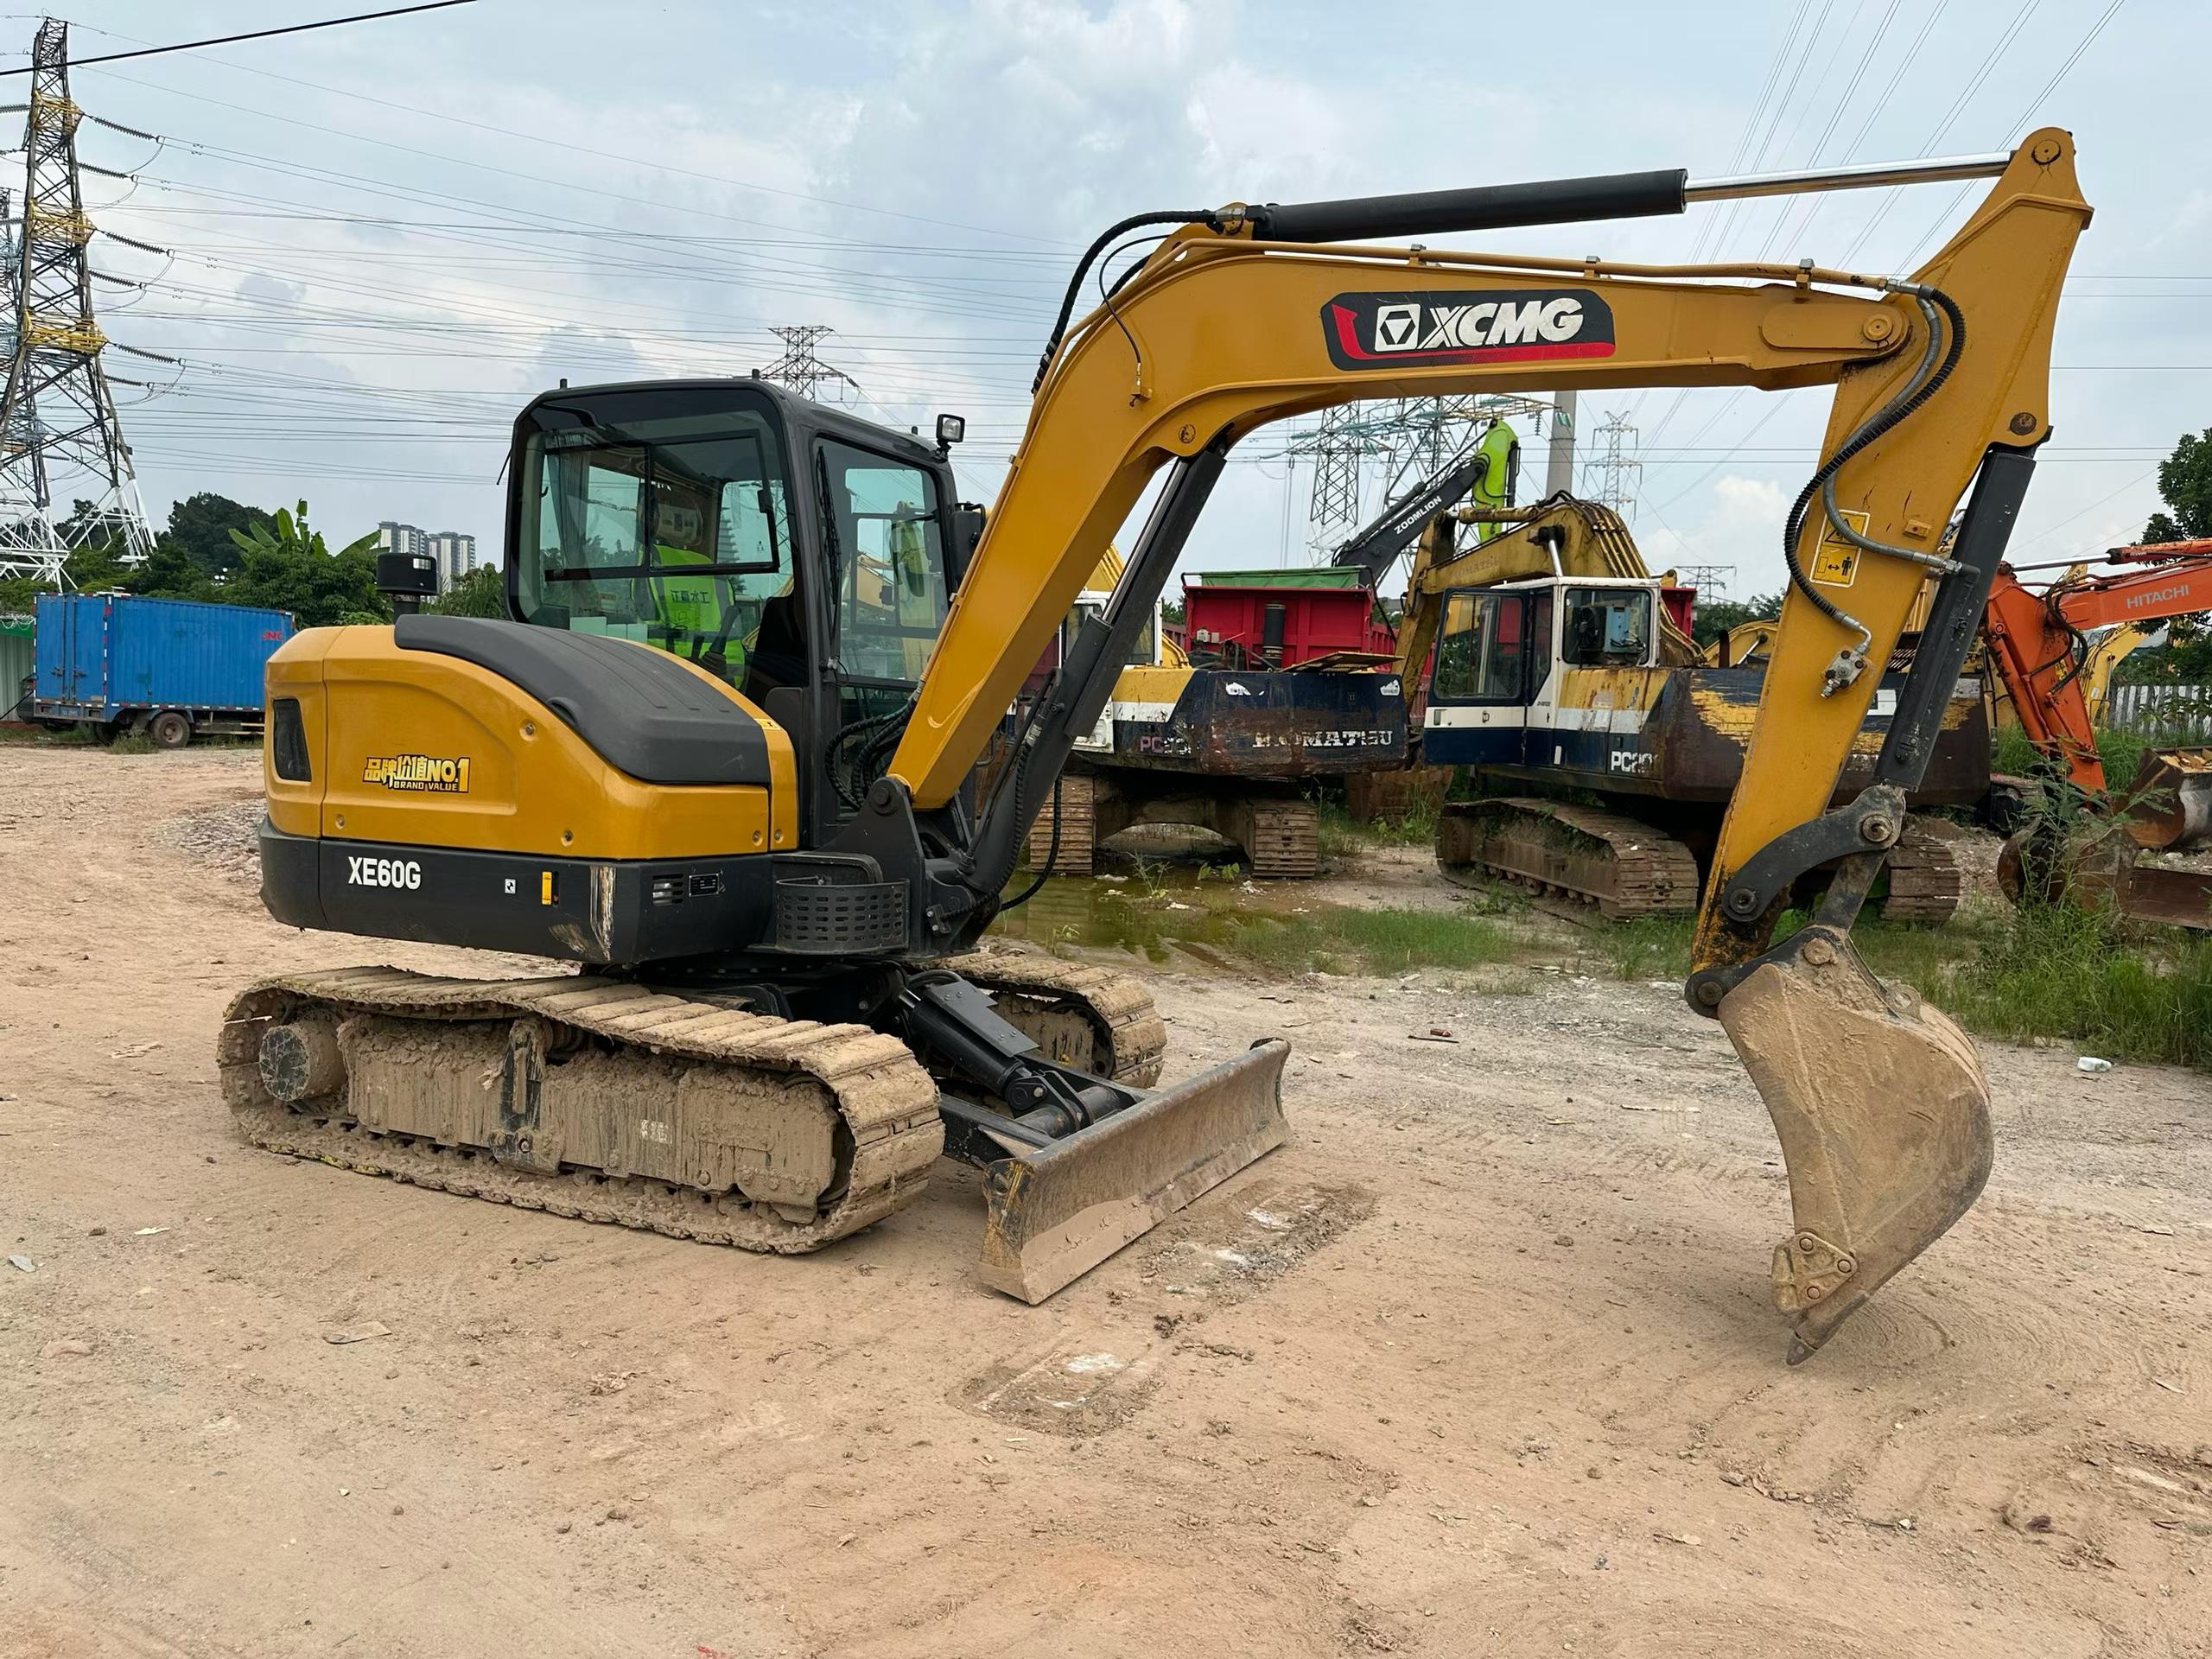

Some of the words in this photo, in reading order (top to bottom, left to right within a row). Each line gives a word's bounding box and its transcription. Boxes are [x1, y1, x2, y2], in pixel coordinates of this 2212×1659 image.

[1416, 298, 1583, 349] XCMG
[1394, 495, 1442, 535] ZOOMLION
[2126, 584, 2190, 609] HITACHI
[393, 781, 424, 790] BRAND
[428, 782, 457, 791] VALUE
[348, 856, 421, 890] XE60G
